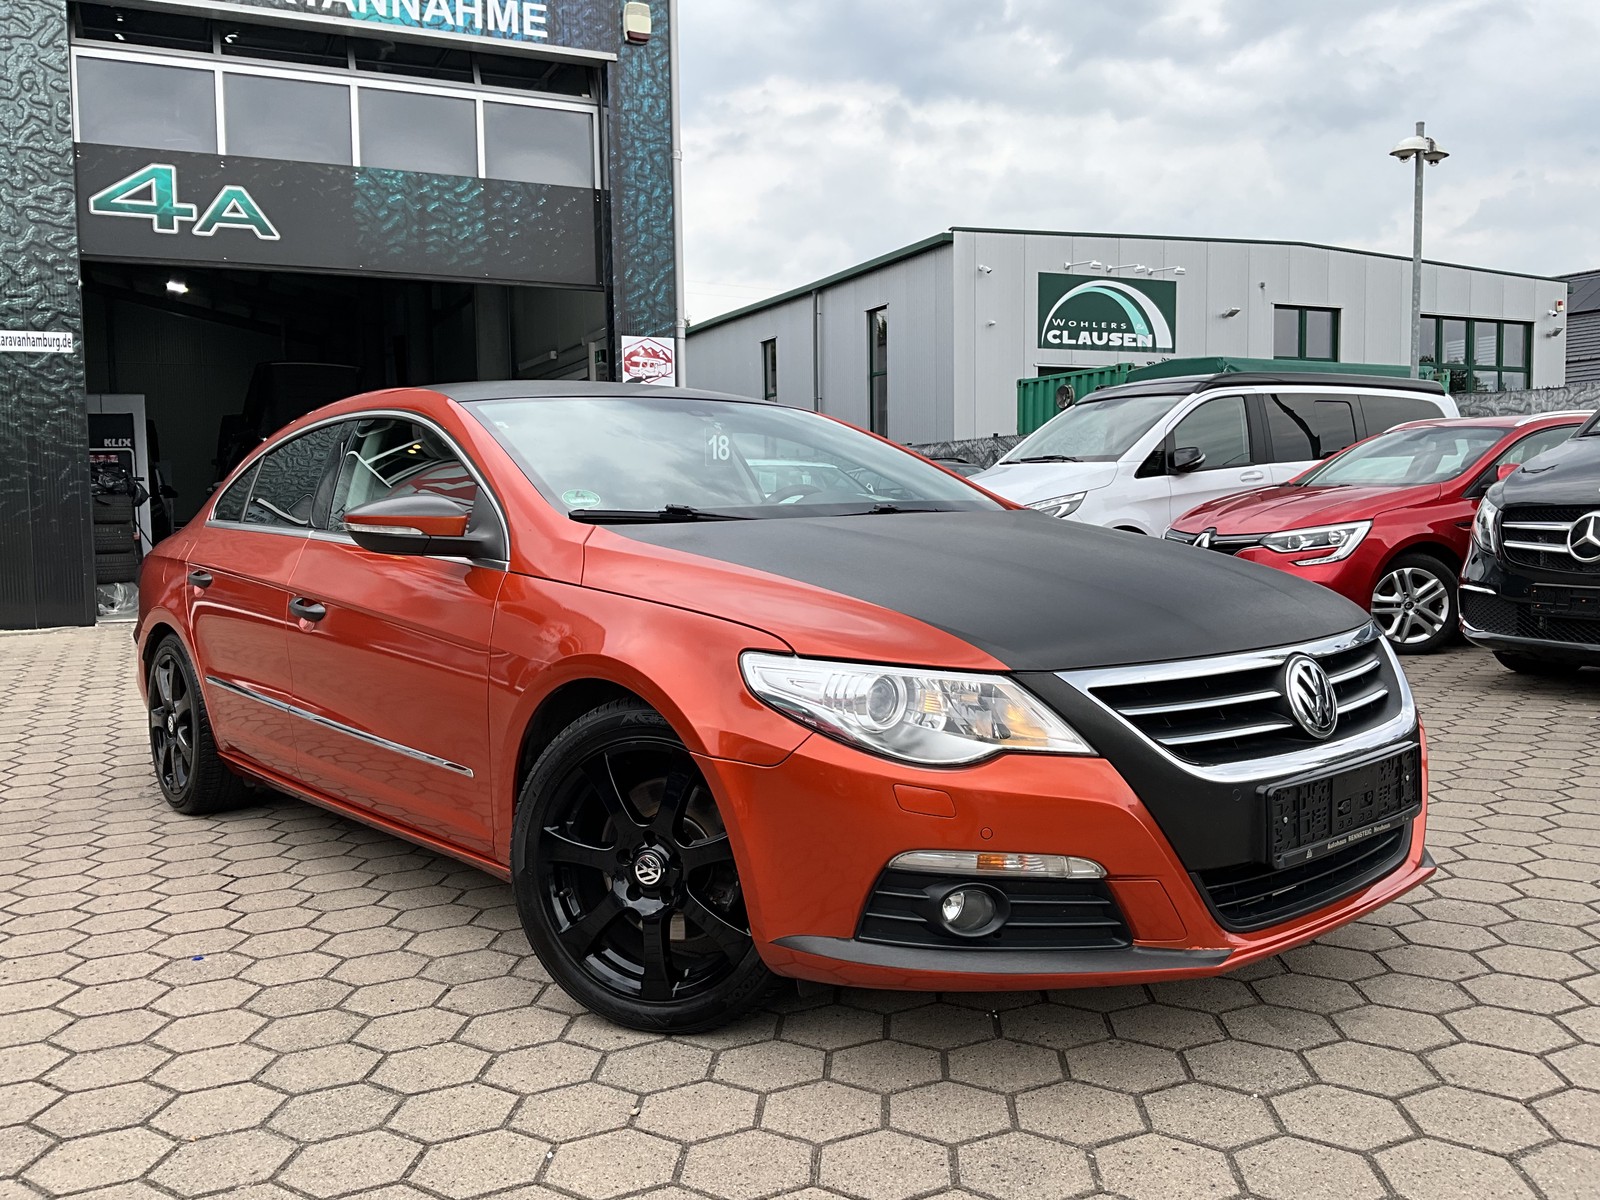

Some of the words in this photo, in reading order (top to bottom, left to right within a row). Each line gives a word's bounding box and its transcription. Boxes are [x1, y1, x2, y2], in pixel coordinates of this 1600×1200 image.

[88, 163, 281, 241] 4A
[1052, 318, 1127, 329] WOHLERS
[0, 333, 72, 351] aravanhamburg.de
[1046, 330, 1153, 347] CLAUSEN
[103, 438, 132, 447] KLIX
[708, 434, 730, 461] 18
